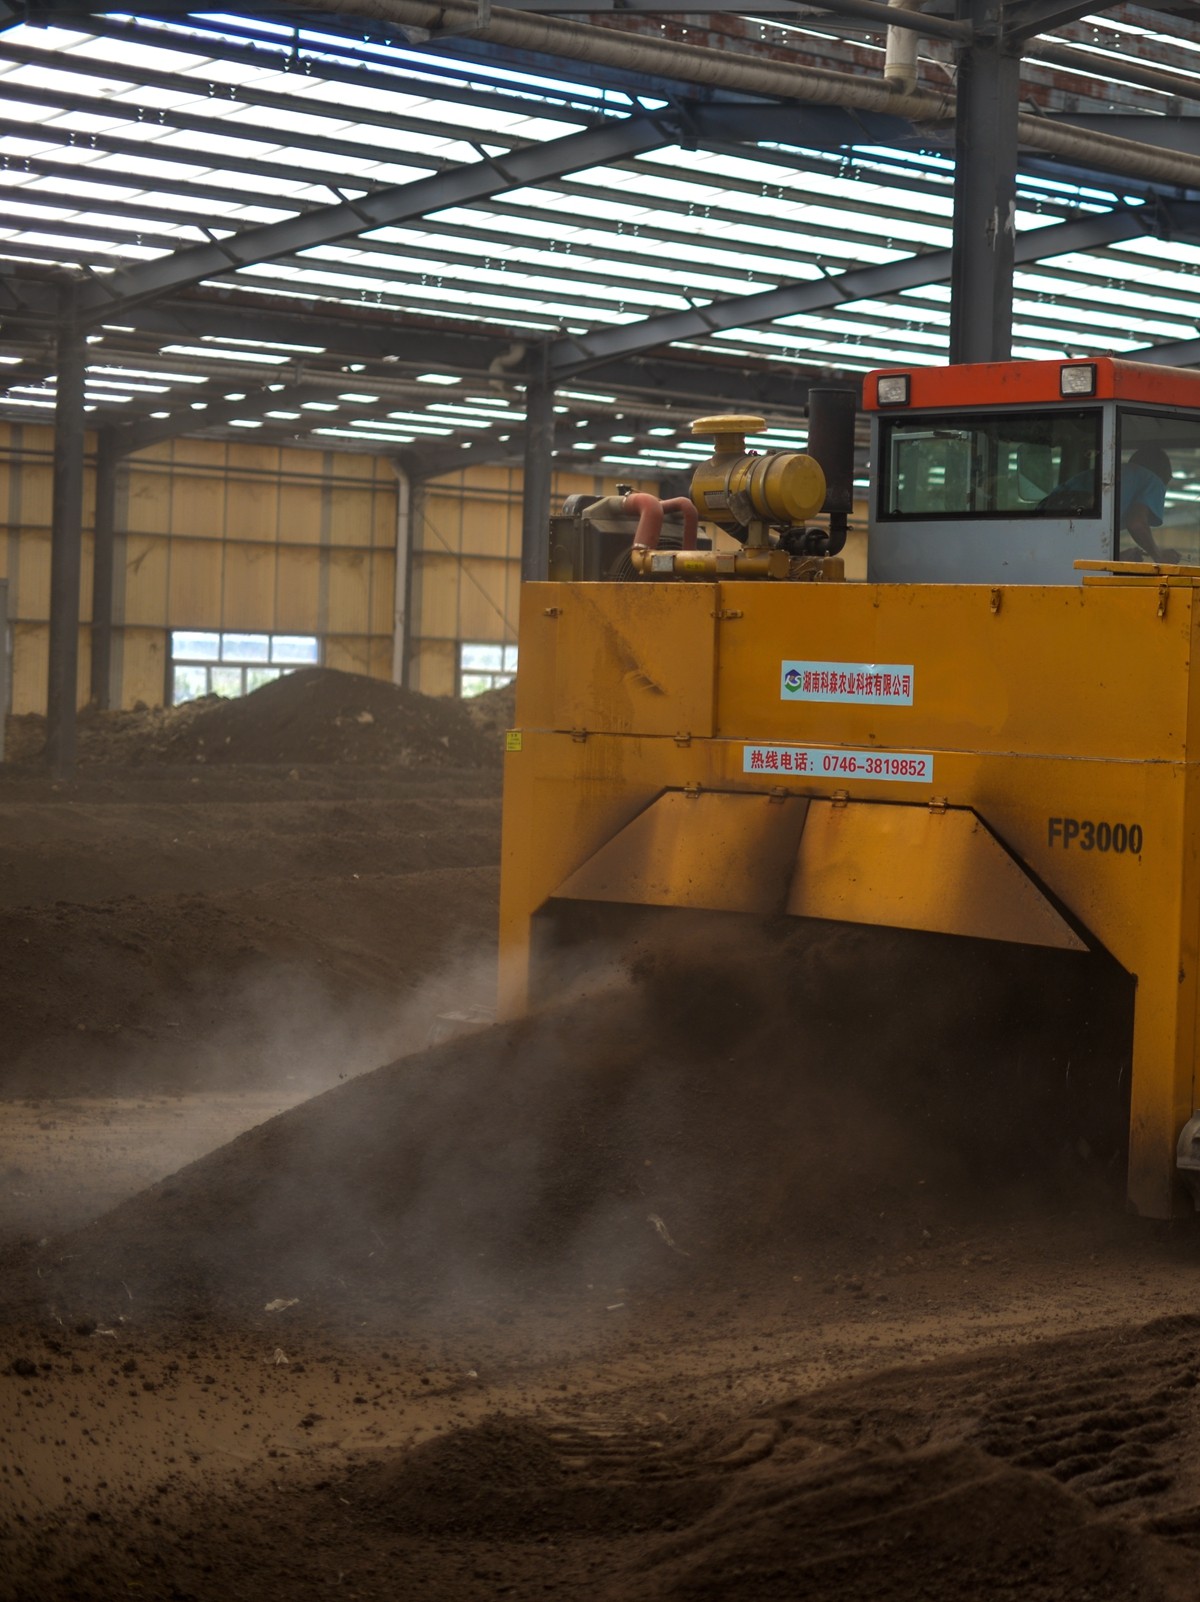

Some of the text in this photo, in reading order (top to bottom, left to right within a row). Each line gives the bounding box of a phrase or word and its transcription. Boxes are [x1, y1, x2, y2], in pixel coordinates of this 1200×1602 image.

[802, 671, 910, 697] 湖南科森农业科技有限公司
[1047, 817, 1143, 854] FP3000
